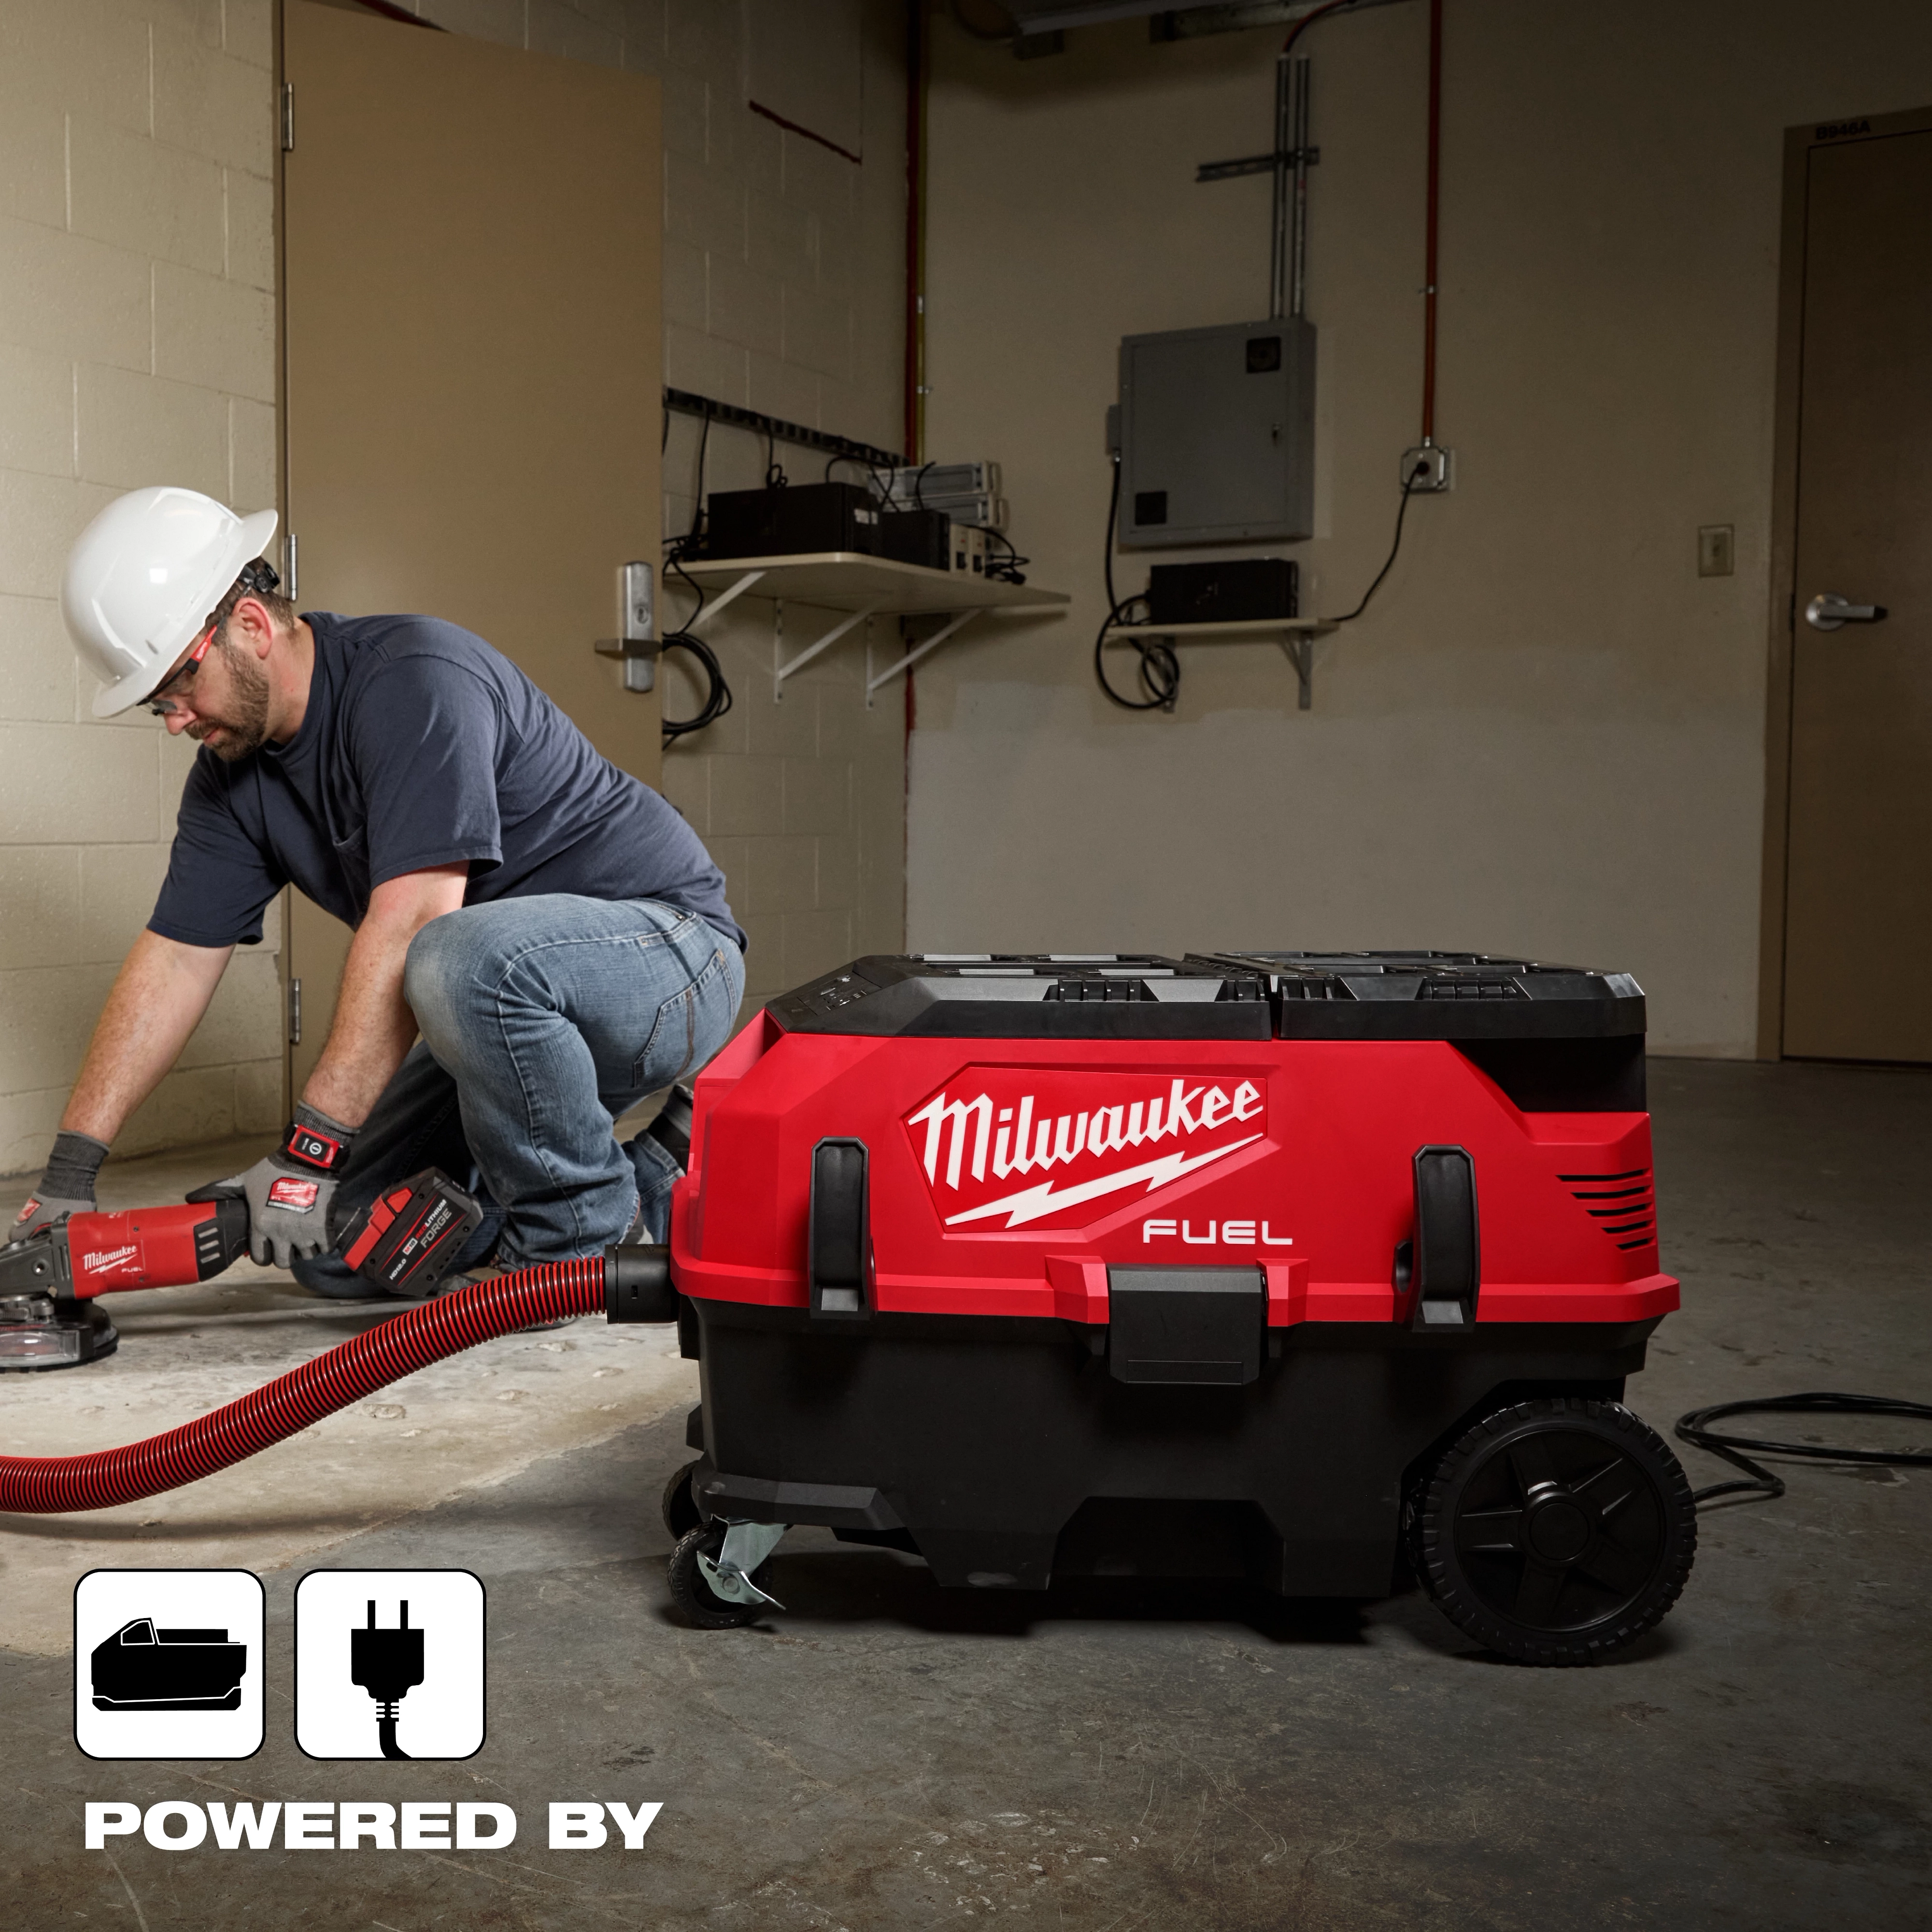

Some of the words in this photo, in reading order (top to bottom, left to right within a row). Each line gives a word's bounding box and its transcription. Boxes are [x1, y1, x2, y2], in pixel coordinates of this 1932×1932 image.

[908, 1079, 1264, 1191] Milwaukee
[404, 1239, 416, 1253] M18
[415, 1199, 447, 1239] REDLITHIUM
[420, 1208, 452, 1248] FORGE
[1143, 1219, 1293, 1246] FUEL
[82, 1245, 138, 1270] Milwaukee
[389, 1258, 407, 1280] HD12.0
